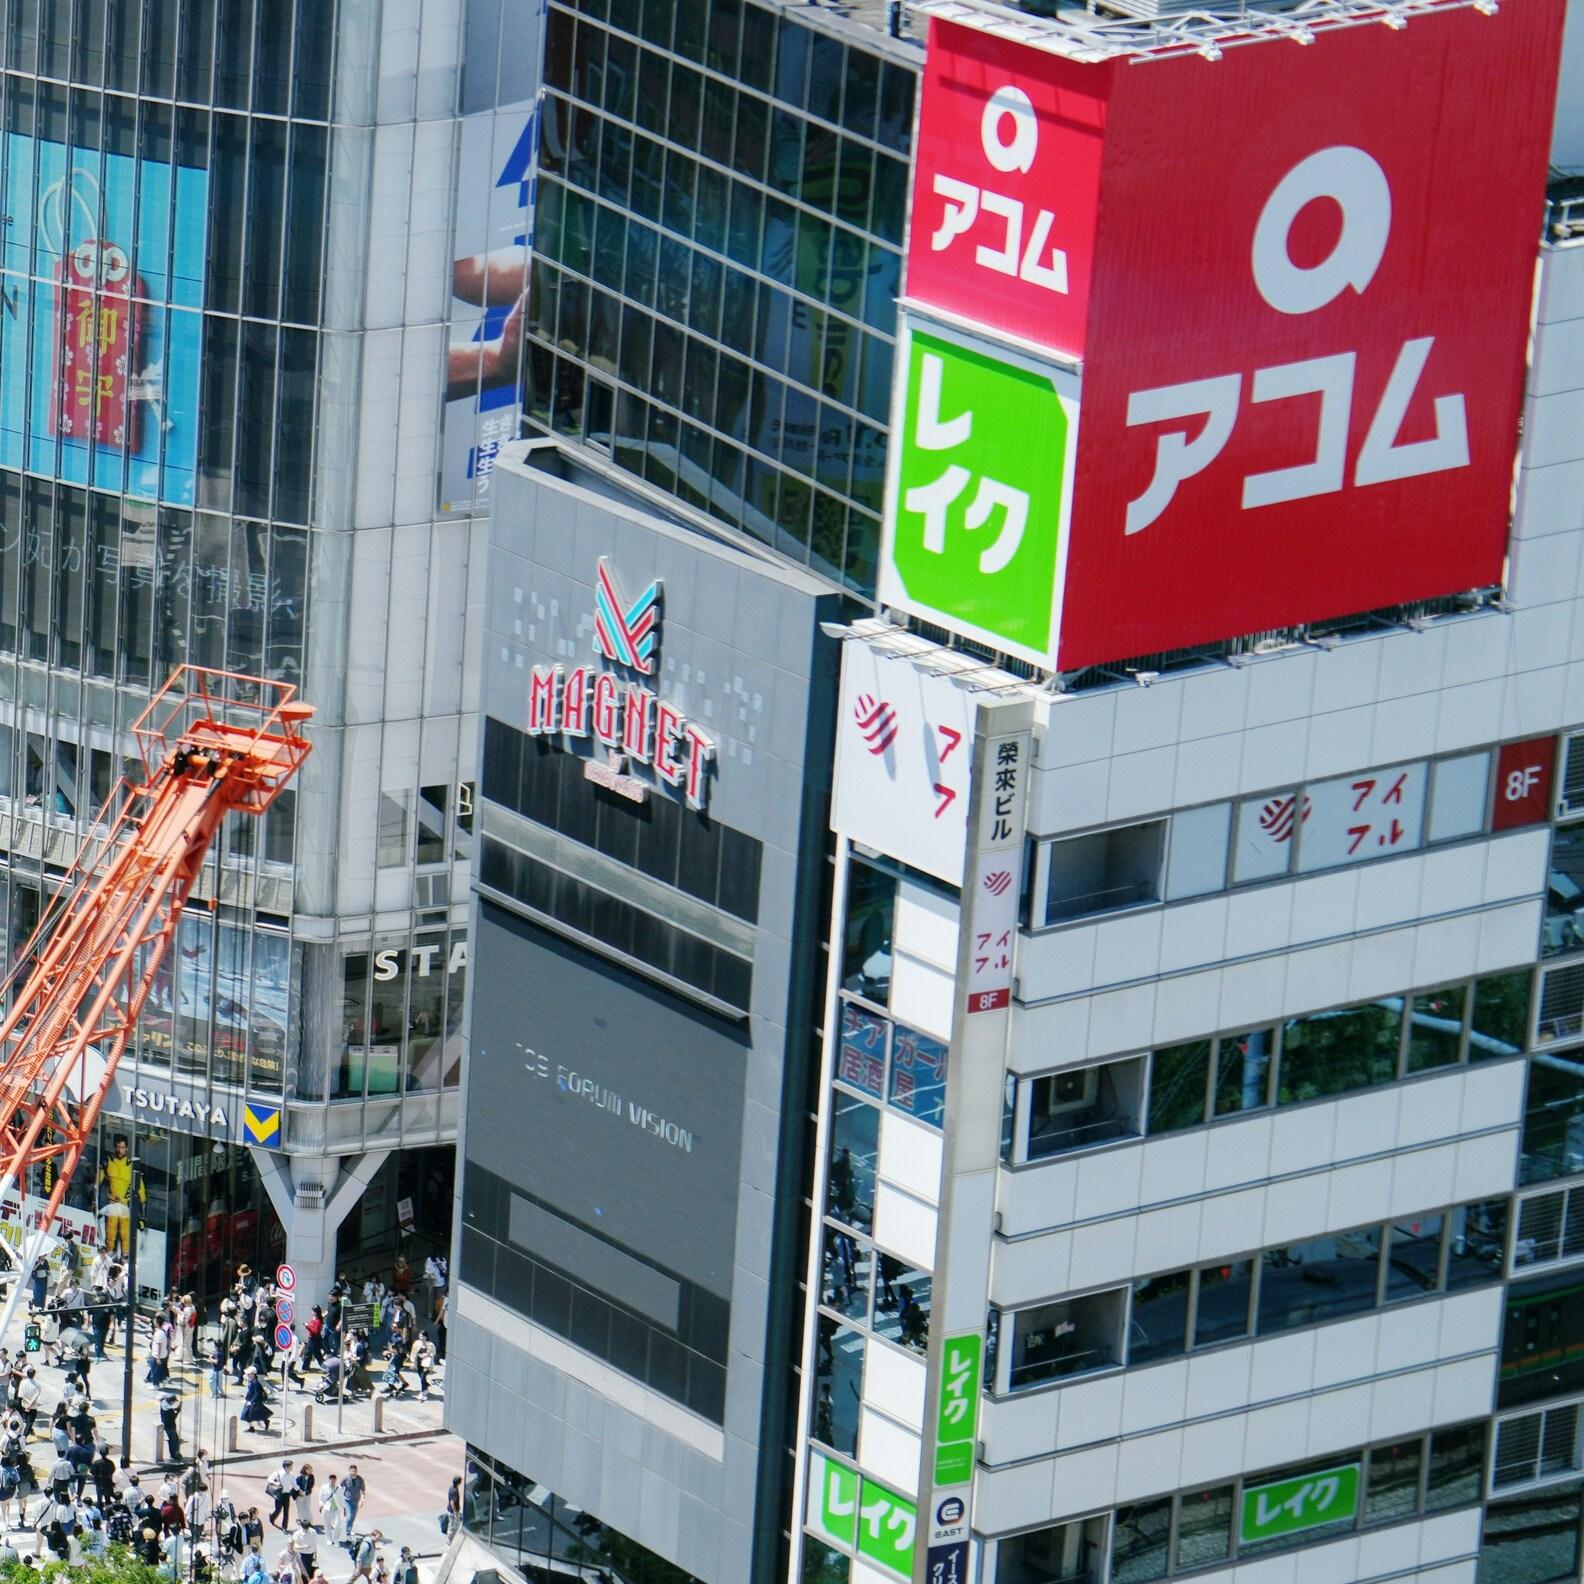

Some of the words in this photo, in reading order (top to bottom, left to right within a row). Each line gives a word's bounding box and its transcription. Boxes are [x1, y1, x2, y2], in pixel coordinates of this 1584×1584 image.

[931, 172, 1070, 296] アコム
[1124, 335, 1472, 537] アコム
[528, 662, 717, 812] MAGNET
[992, 741, 1019, 841] 榮來ビル
[1506, 765, 1543, 802] 8F
[979, 993, 999, 1010] 8F
[122, 1084, 228, 1128] TSUTAYA
[628, 1100, 694, 1154] VISION
[944, 1349, 972, 1424] レイク
[828, 1470, 916, 1551] レイク
[934, 1527, 964, 1539] EAST
[1255, 1475, 1340, 1528] レイク
